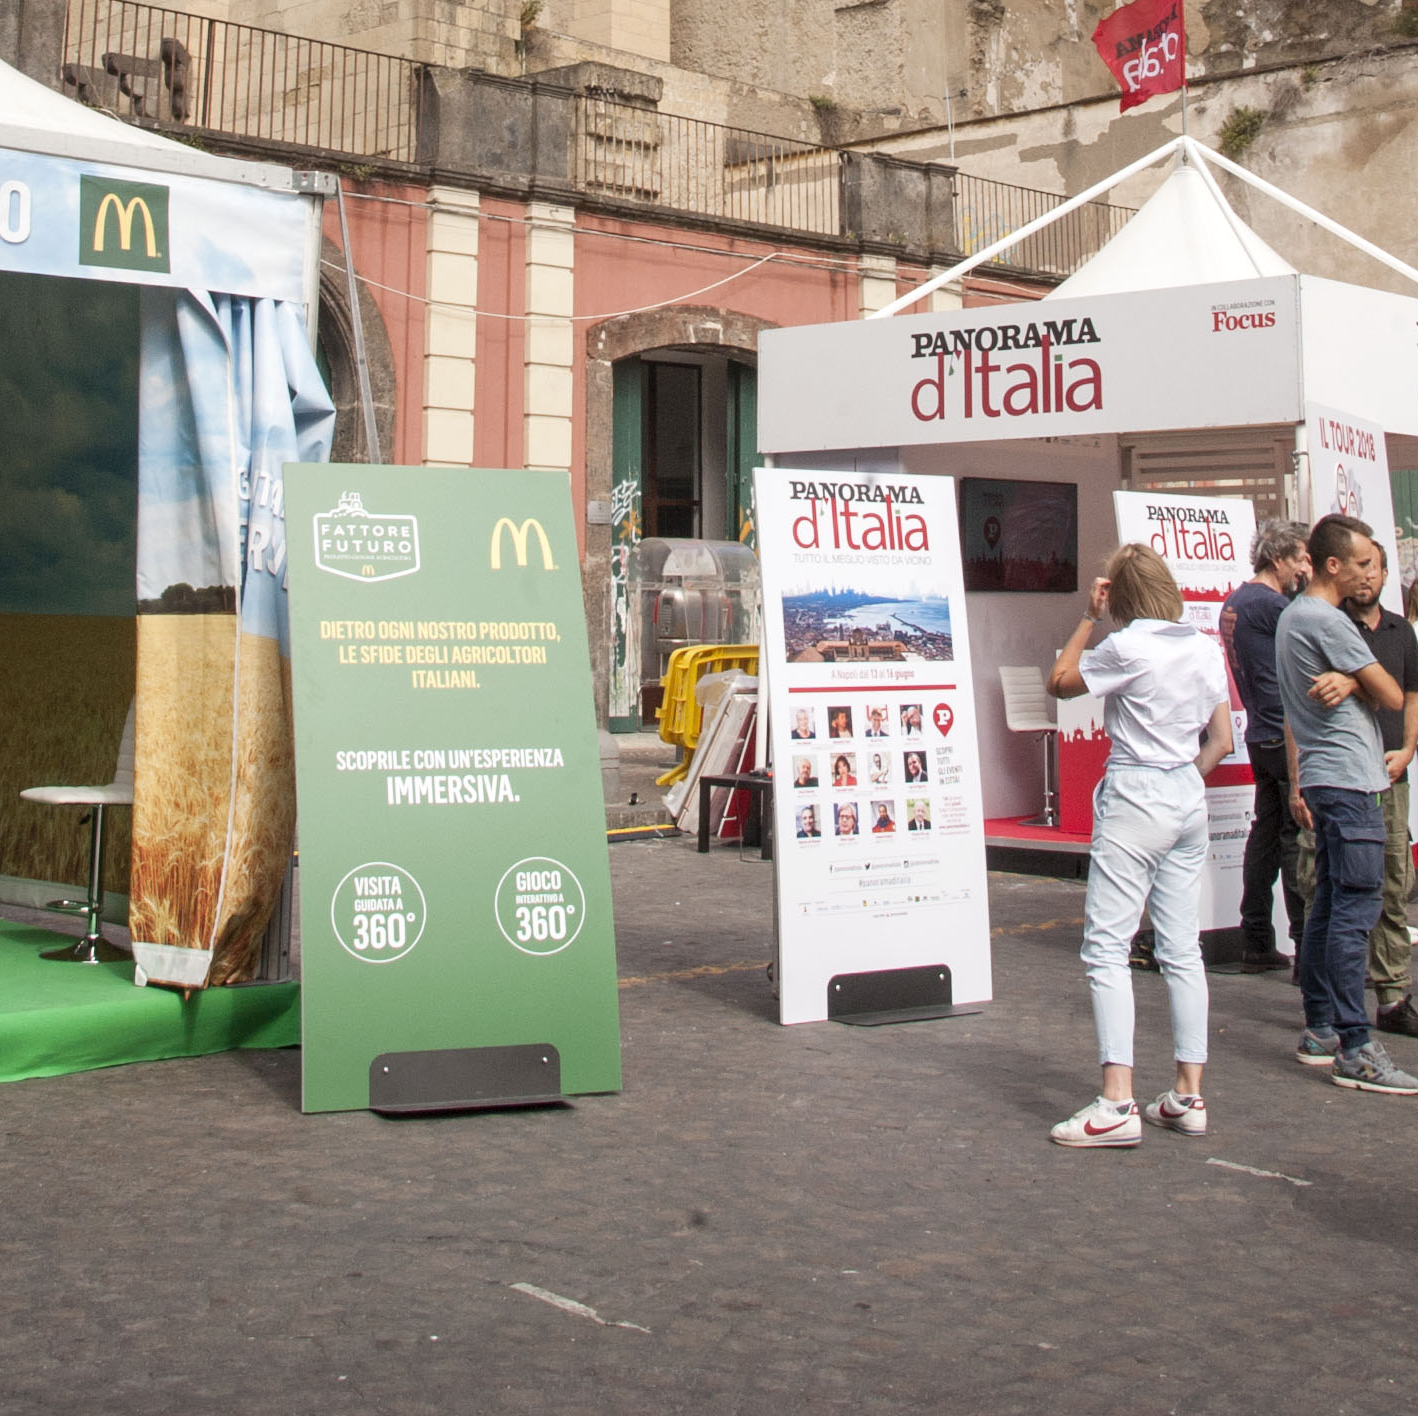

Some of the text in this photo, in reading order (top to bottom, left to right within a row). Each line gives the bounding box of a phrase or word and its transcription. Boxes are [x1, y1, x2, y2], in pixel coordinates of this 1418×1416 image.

[1211, 311, 1276, 332] Focus
[911, 317, 1101, 359] PANORAMA
[911, 334, 1103, 422] d'Italia
[1319, 417, 1376, 462] IL TOUR 2018
[788, 481, 926, 505] PANORAMA
[792, 494, 930, 552] d'Italia
[1146, 505, 1230, 525] PANORAMA
[321, 524, 411, 537] FATTORE
[1150, 516, 1236, 561] d'Italia
[322, 539, 412, 554] FUTURO
[793, 553, 822, 564] TUTTO
[831, 554, 865, 565] MEGLIO
[867, 555, 890, 565] VISTO
[892, 556, 904, 565] DA
[905, 556, 932, 566] VICINO
[320, 620, 561, 643] DIETRO OGNI NOSTRO PRODOTTO,
[339, 646, 547, 664] LE SFIDE DEGLI AGRICOLTORI
[412, 670, 480, 689] ITALIANI.
[336, 748, 564, 771] SCOPRILE CON UN'ESPERIENZA
[386, 775, 521, 805] IMMERSIVA.
[353, 876, 402, 896] VISITA
[515, 870, 562, 892] GIOCO
[354, 898, 403, 912] GUIDATA A
[515, 892, 565, 905] INTERATTIVO A
